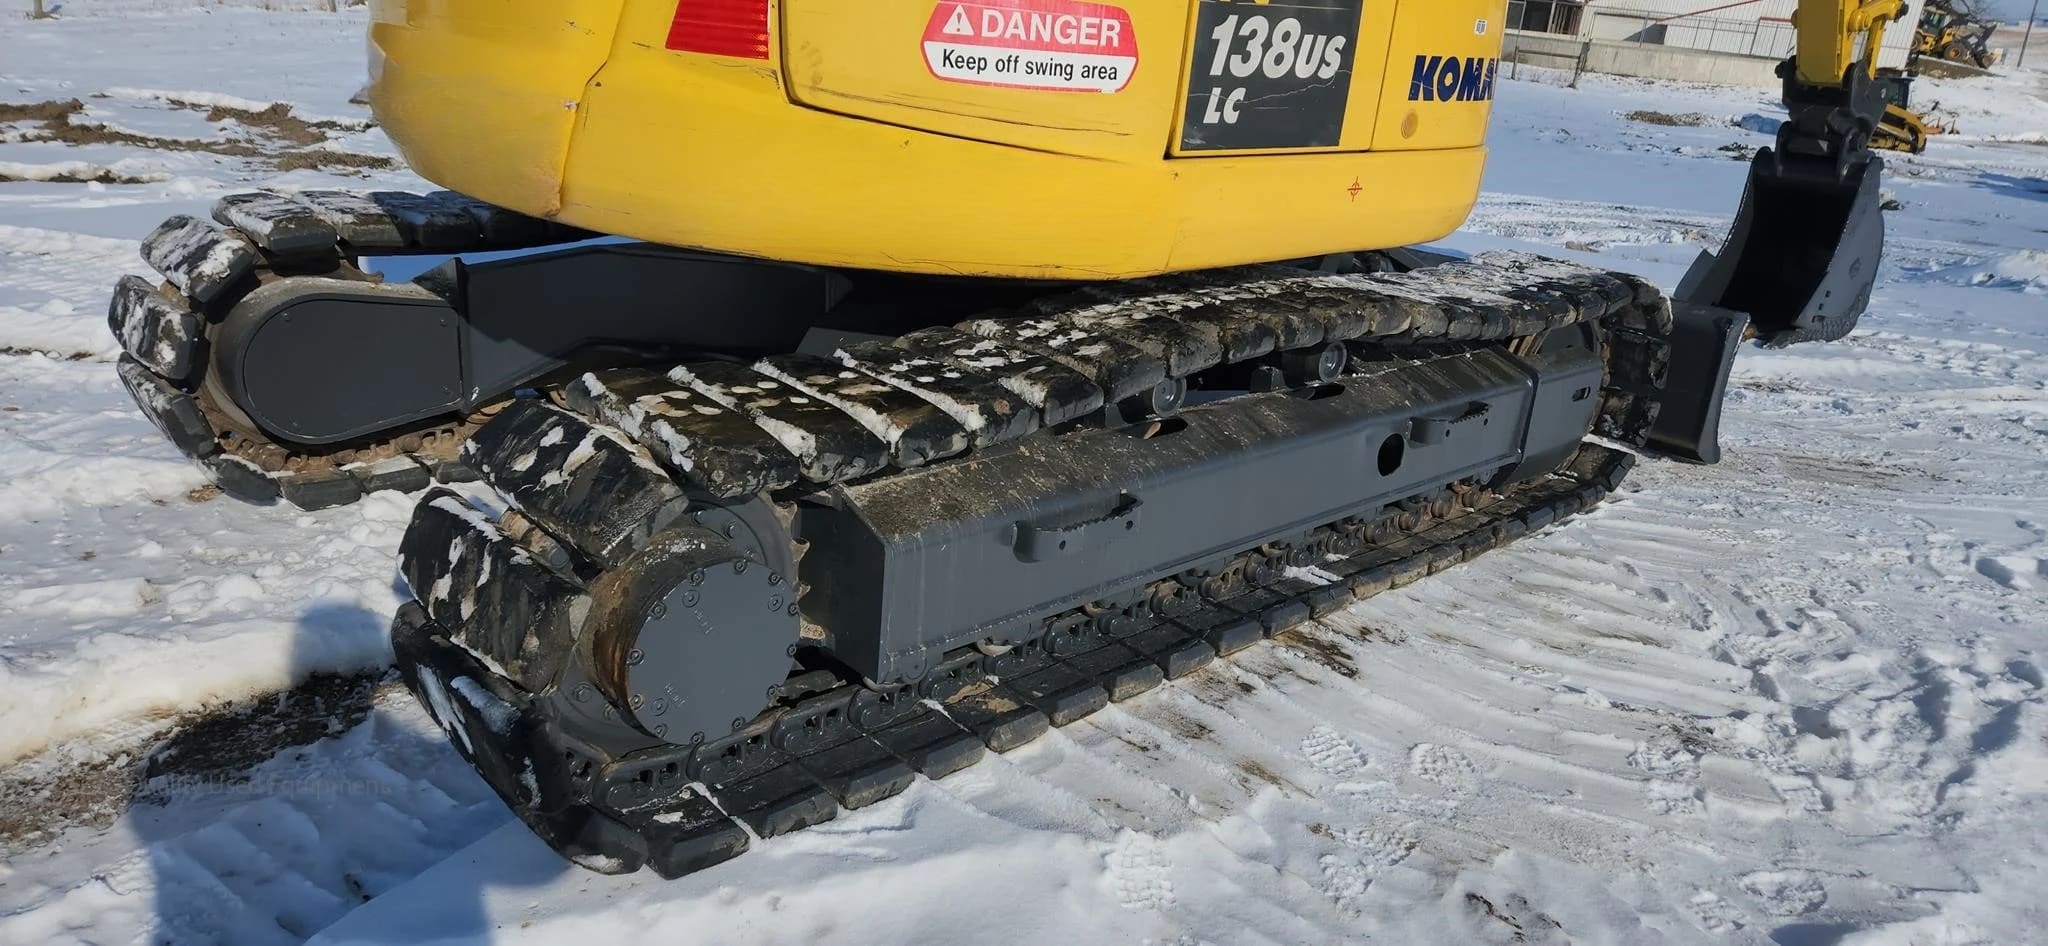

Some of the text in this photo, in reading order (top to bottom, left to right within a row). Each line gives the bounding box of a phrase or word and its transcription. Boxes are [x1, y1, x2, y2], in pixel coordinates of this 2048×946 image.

[981, 9, 1121, 47] DANGER
[1209, 14, 1347, 79] 138US
[942, 48, 1118, 81] Keep off swing area
[1407, 54, 1499, 102] KOMA
[1203, 87, 1247, 124] LC
